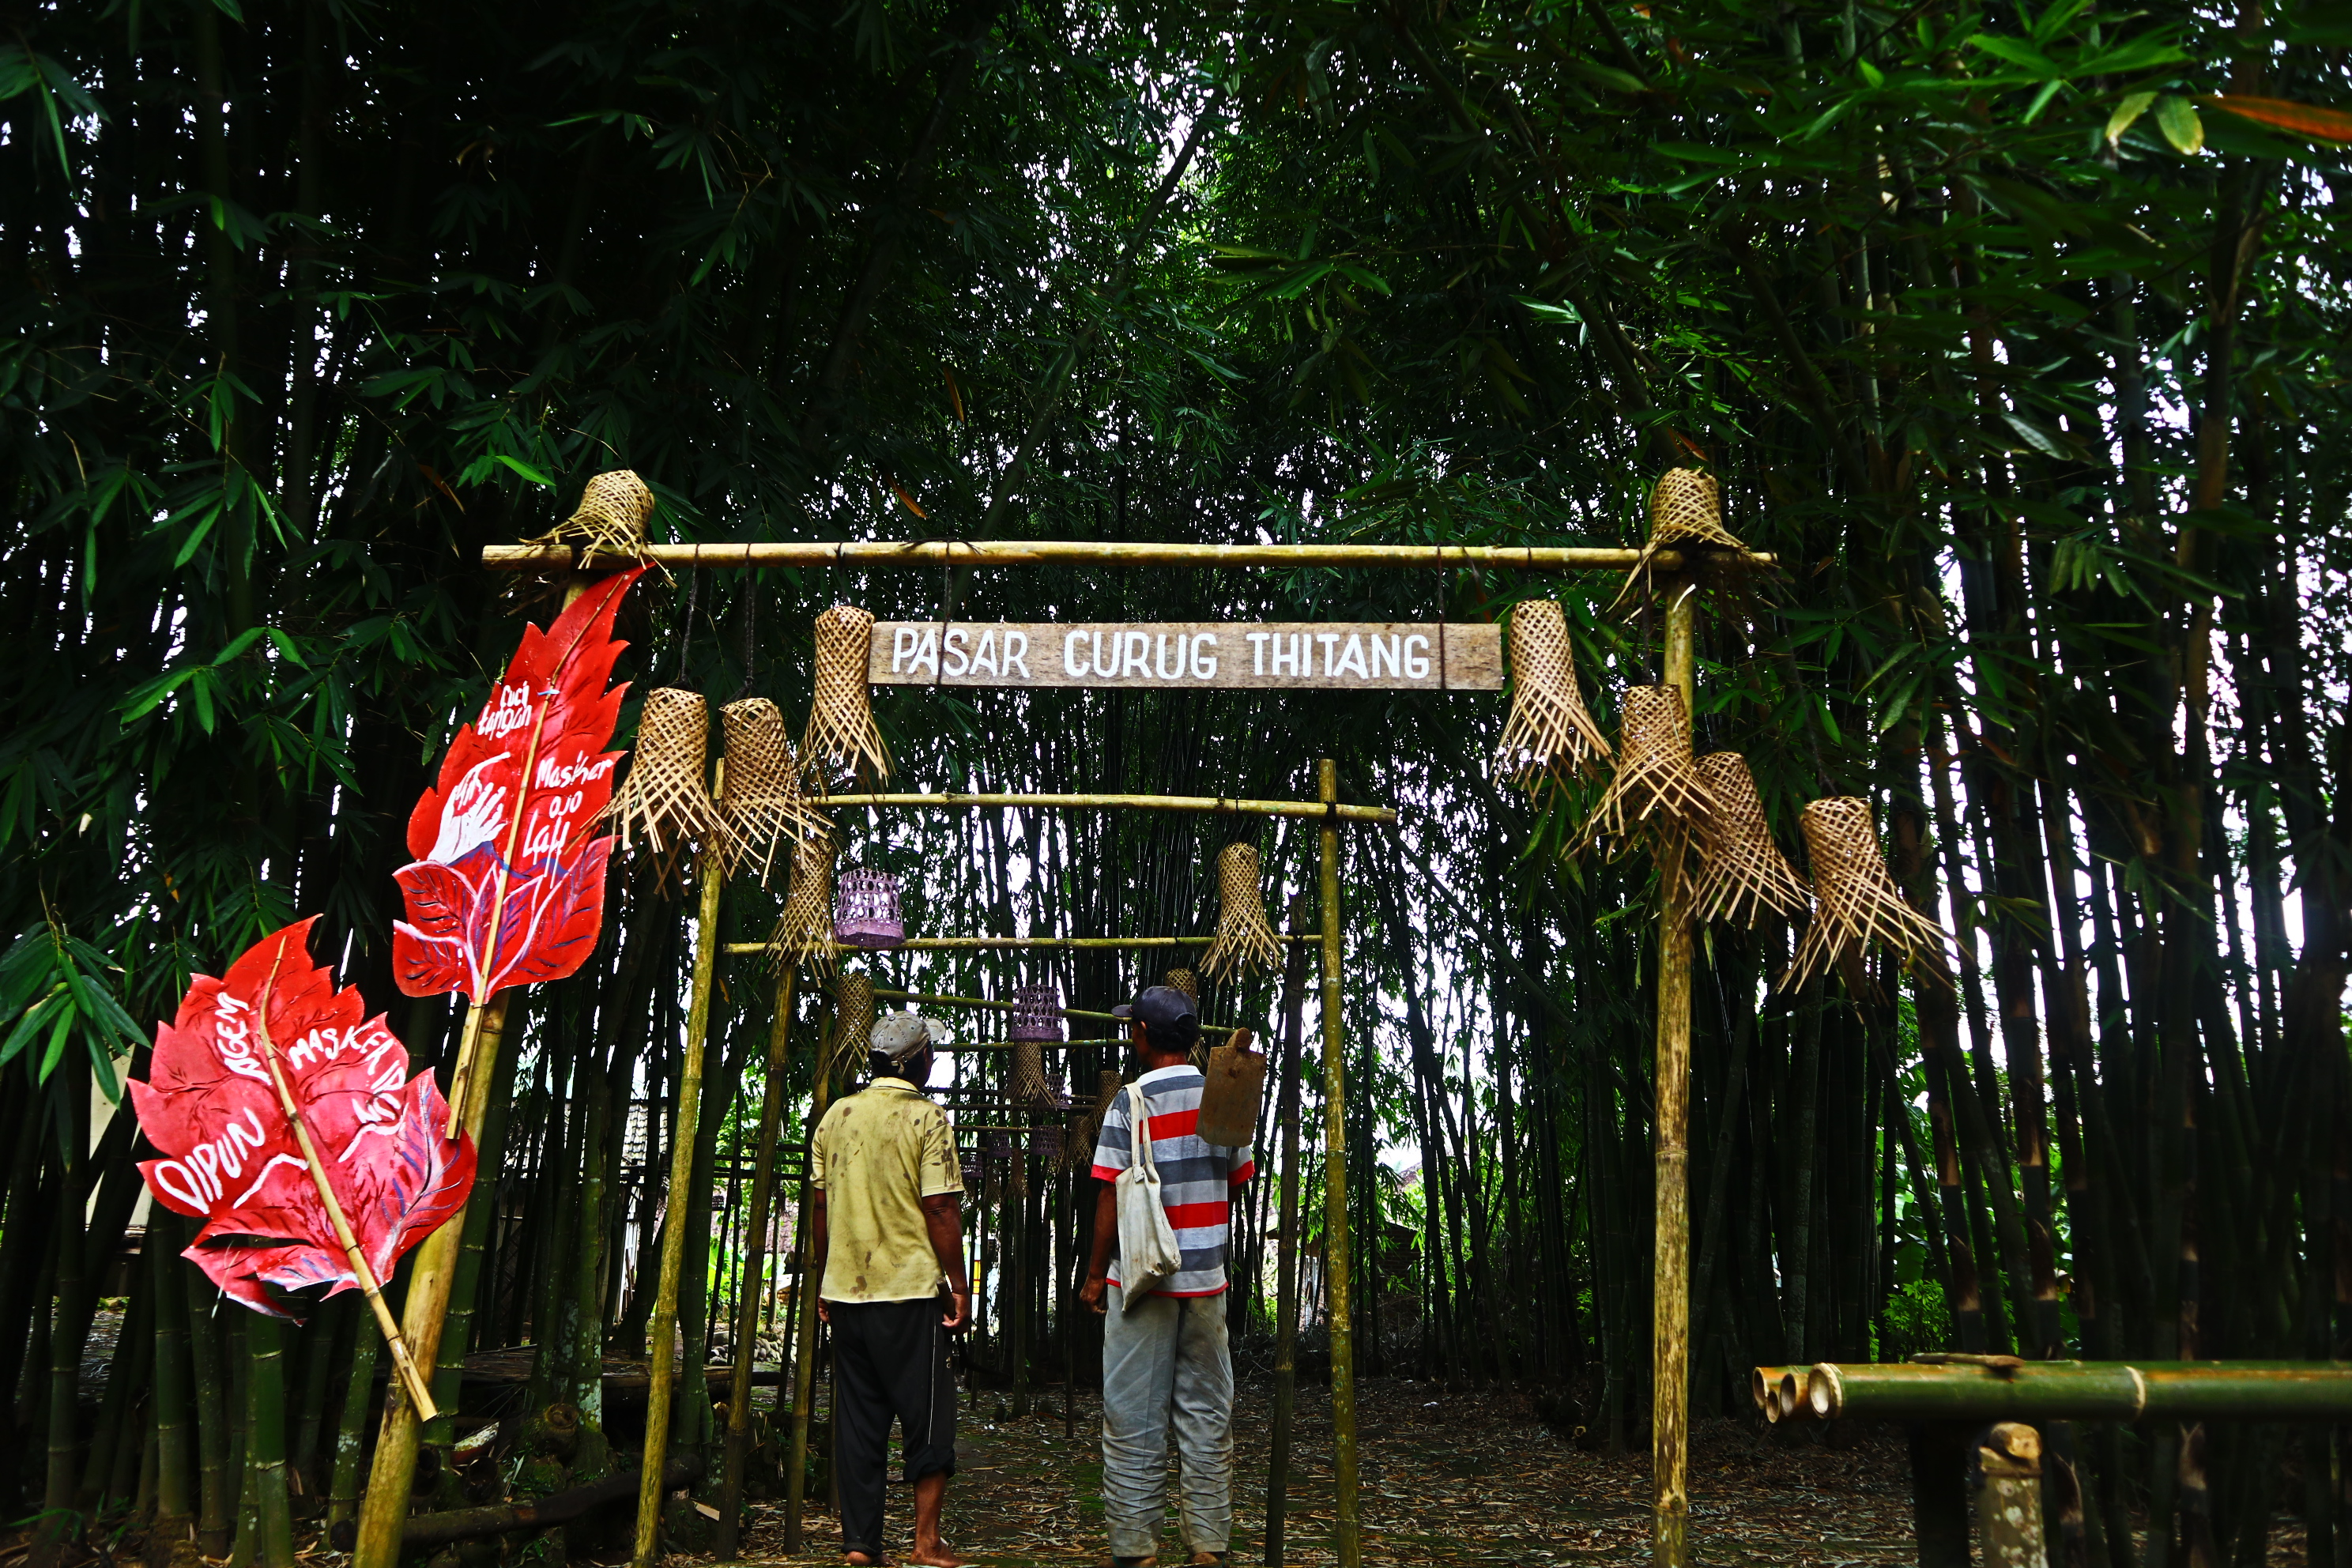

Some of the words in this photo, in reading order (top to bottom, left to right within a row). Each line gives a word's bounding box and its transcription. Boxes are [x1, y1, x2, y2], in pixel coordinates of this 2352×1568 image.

[891, 627, 1031, 678] PASAR
[1064, 629, 1217, 680] CURUG
[1246, 632, 1430, 680] THITANG
[155, 1106, 266, 1215] DIPUN
[215, 991, 273, 1087] AGEM
